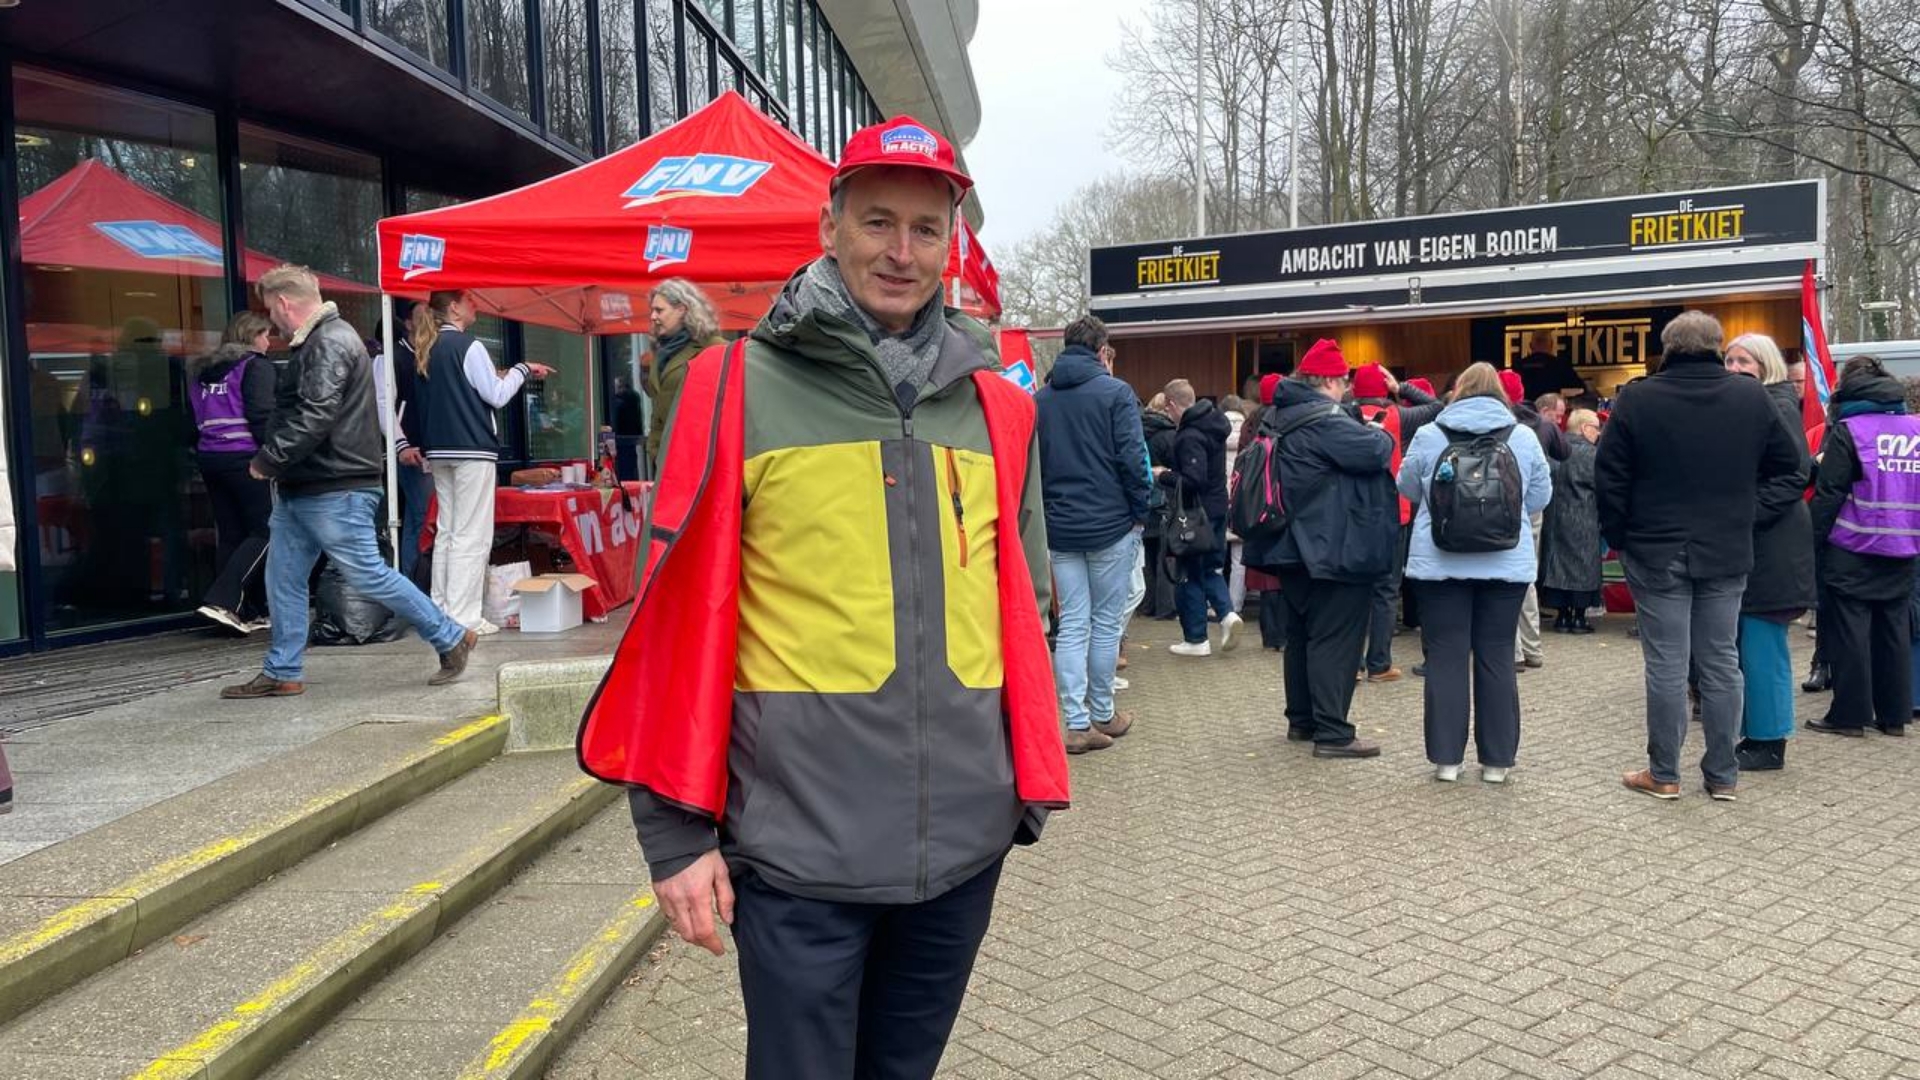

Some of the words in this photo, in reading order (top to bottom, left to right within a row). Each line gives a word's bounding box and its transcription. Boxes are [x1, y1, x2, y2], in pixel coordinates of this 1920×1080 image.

[637, 163, 767, 190] FNV
[1679, 199, 1693, 213] DE
[1631, 209, 1744, 245] FRIETKIET
[402, 240, 443, 262] FNV
[647, 233, 690, 253] FNV
[1172, 245, 1184, 258] DE
[1280, 242, 1367, 274] AMBACHT
[1373, 239, 1411, 267] VAN
[1419, 233, 1476, 264] EIGEN
[1486, 226, 1558, 259] BODEM
[1138, 254, 1221, 285] FRIETKIET
[1504, 325, 1652, 368] FRETKIET
[567, 497, 604, 555] in
